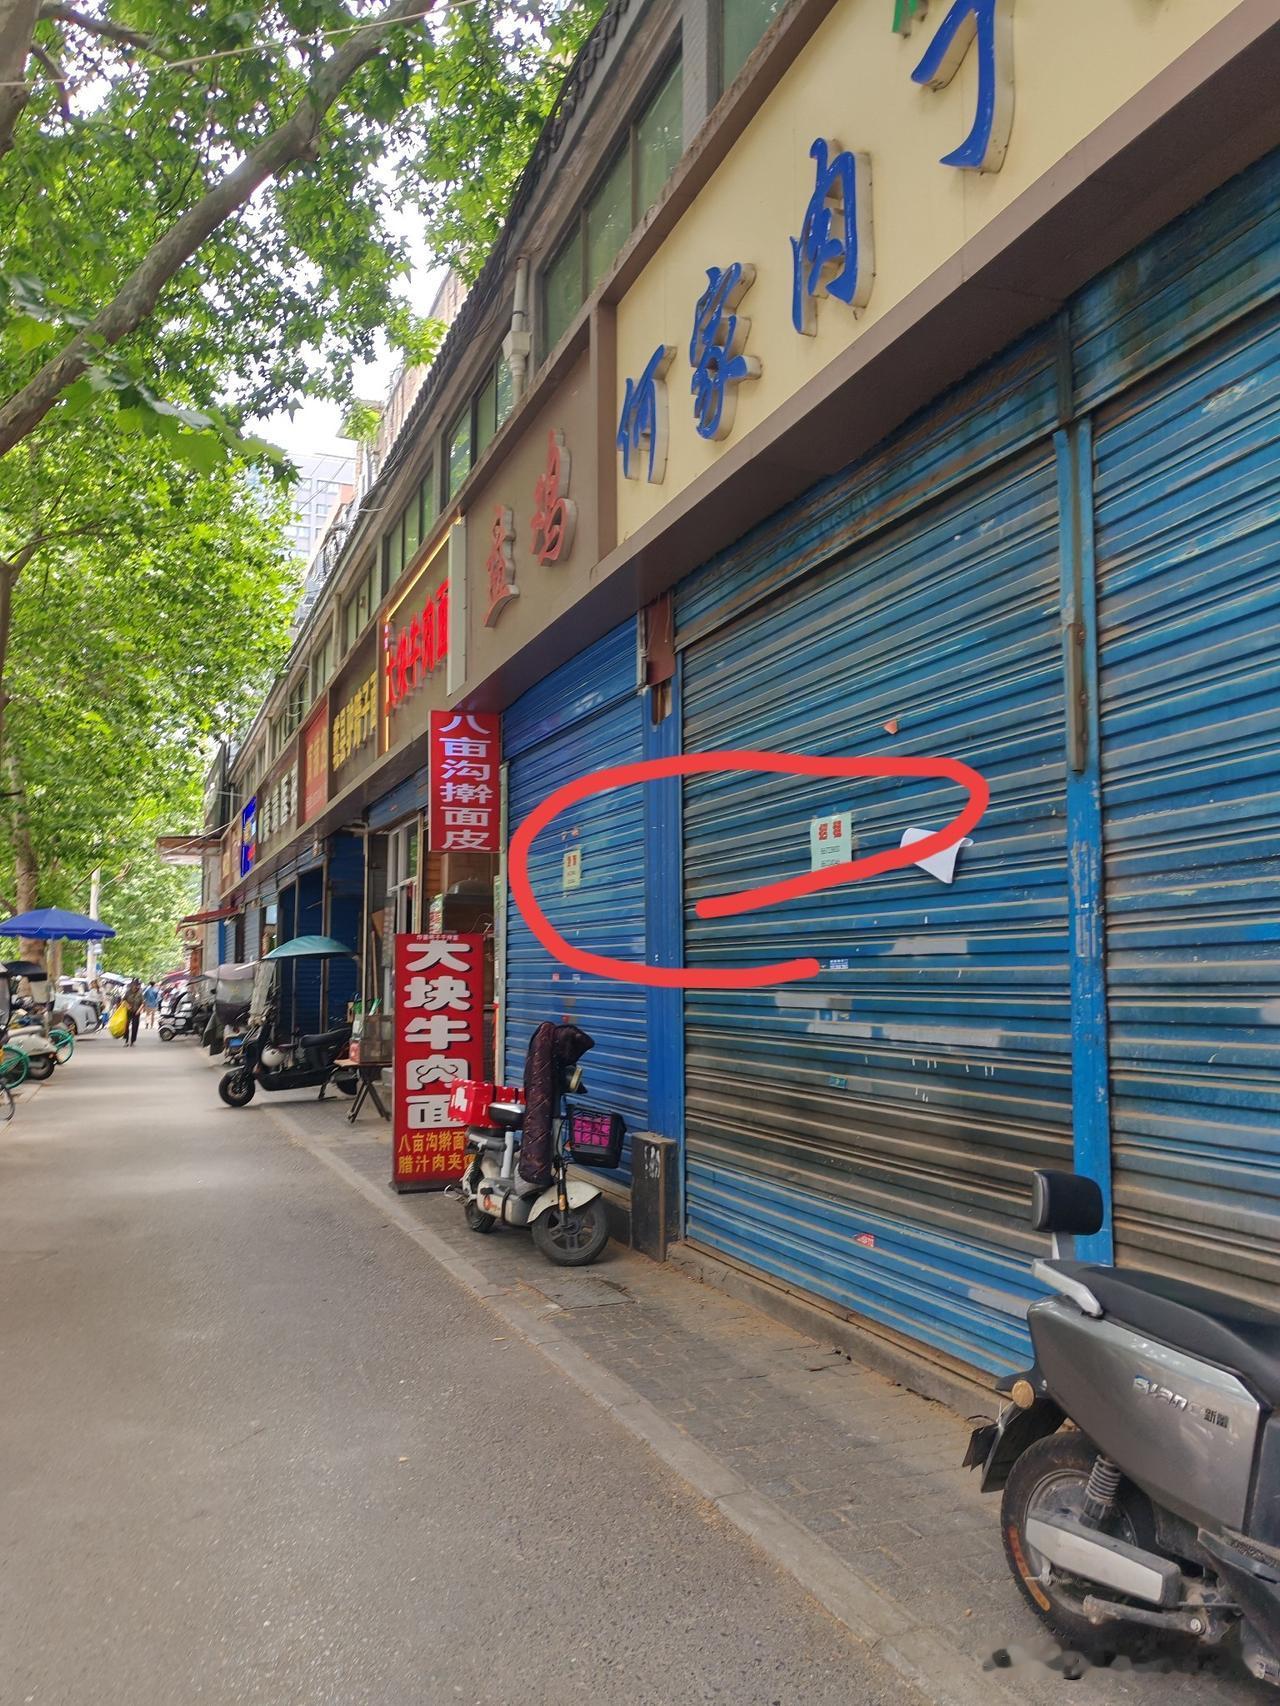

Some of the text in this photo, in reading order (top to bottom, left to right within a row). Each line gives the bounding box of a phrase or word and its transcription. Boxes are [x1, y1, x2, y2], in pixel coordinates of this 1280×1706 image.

[438, 714, 493, 851] 八亩沟擀面皮
[403, 939, 471, 1129] 大块牛肉面
